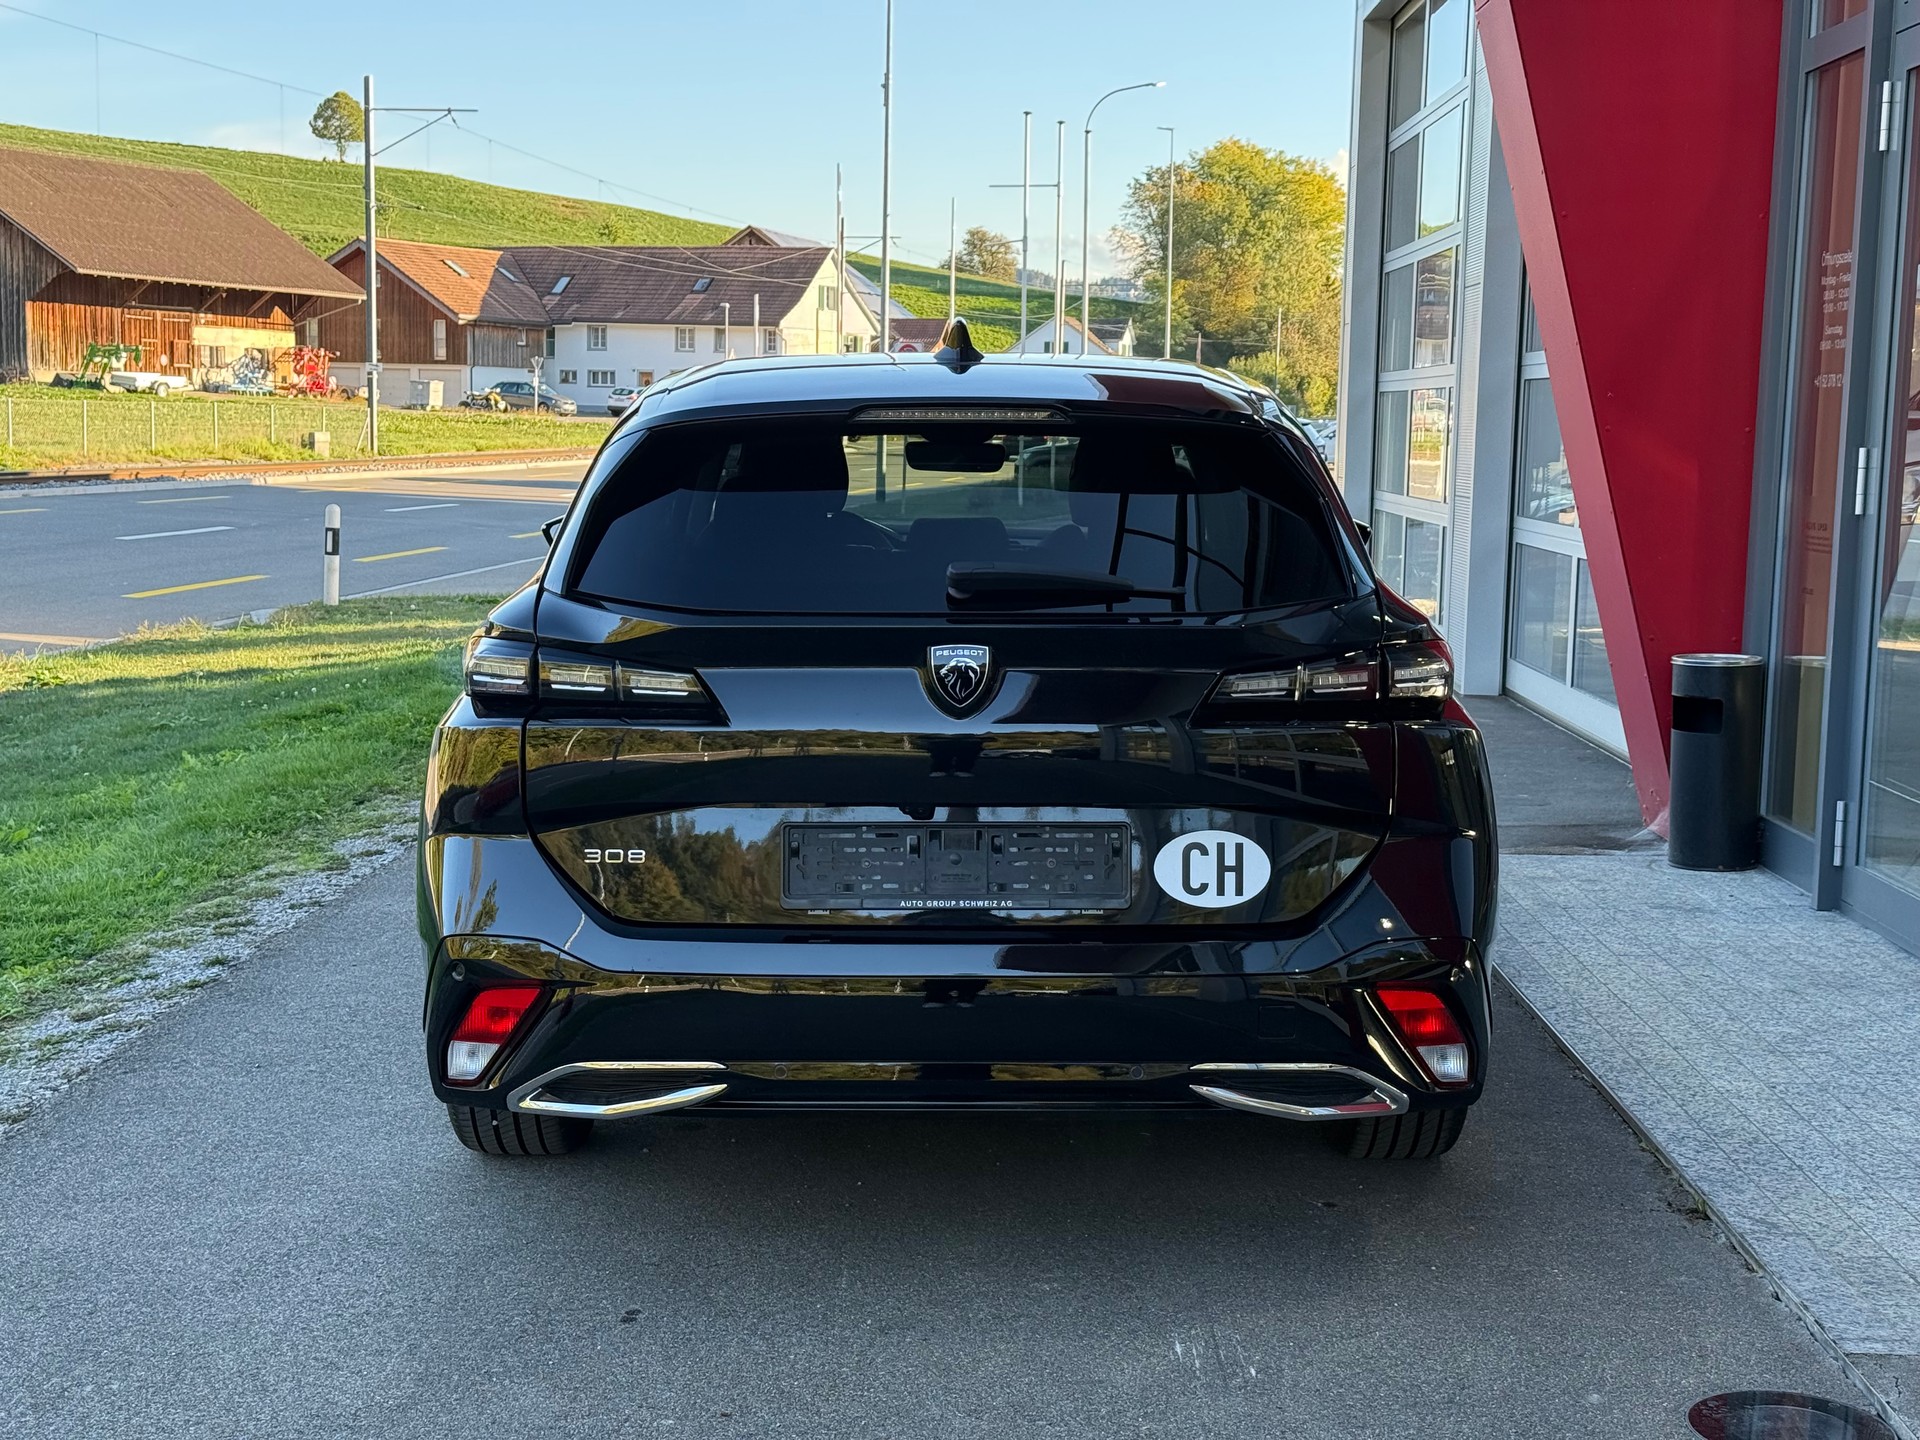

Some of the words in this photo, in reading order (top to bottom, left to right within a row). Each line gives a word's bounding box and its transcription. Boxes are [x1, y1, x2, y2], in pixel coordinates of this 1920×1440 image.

[936, 649, 984, 657] PEUGEOT
[584, 848, 646, 864] 308
[1181, 841, 1244, 897] CH
